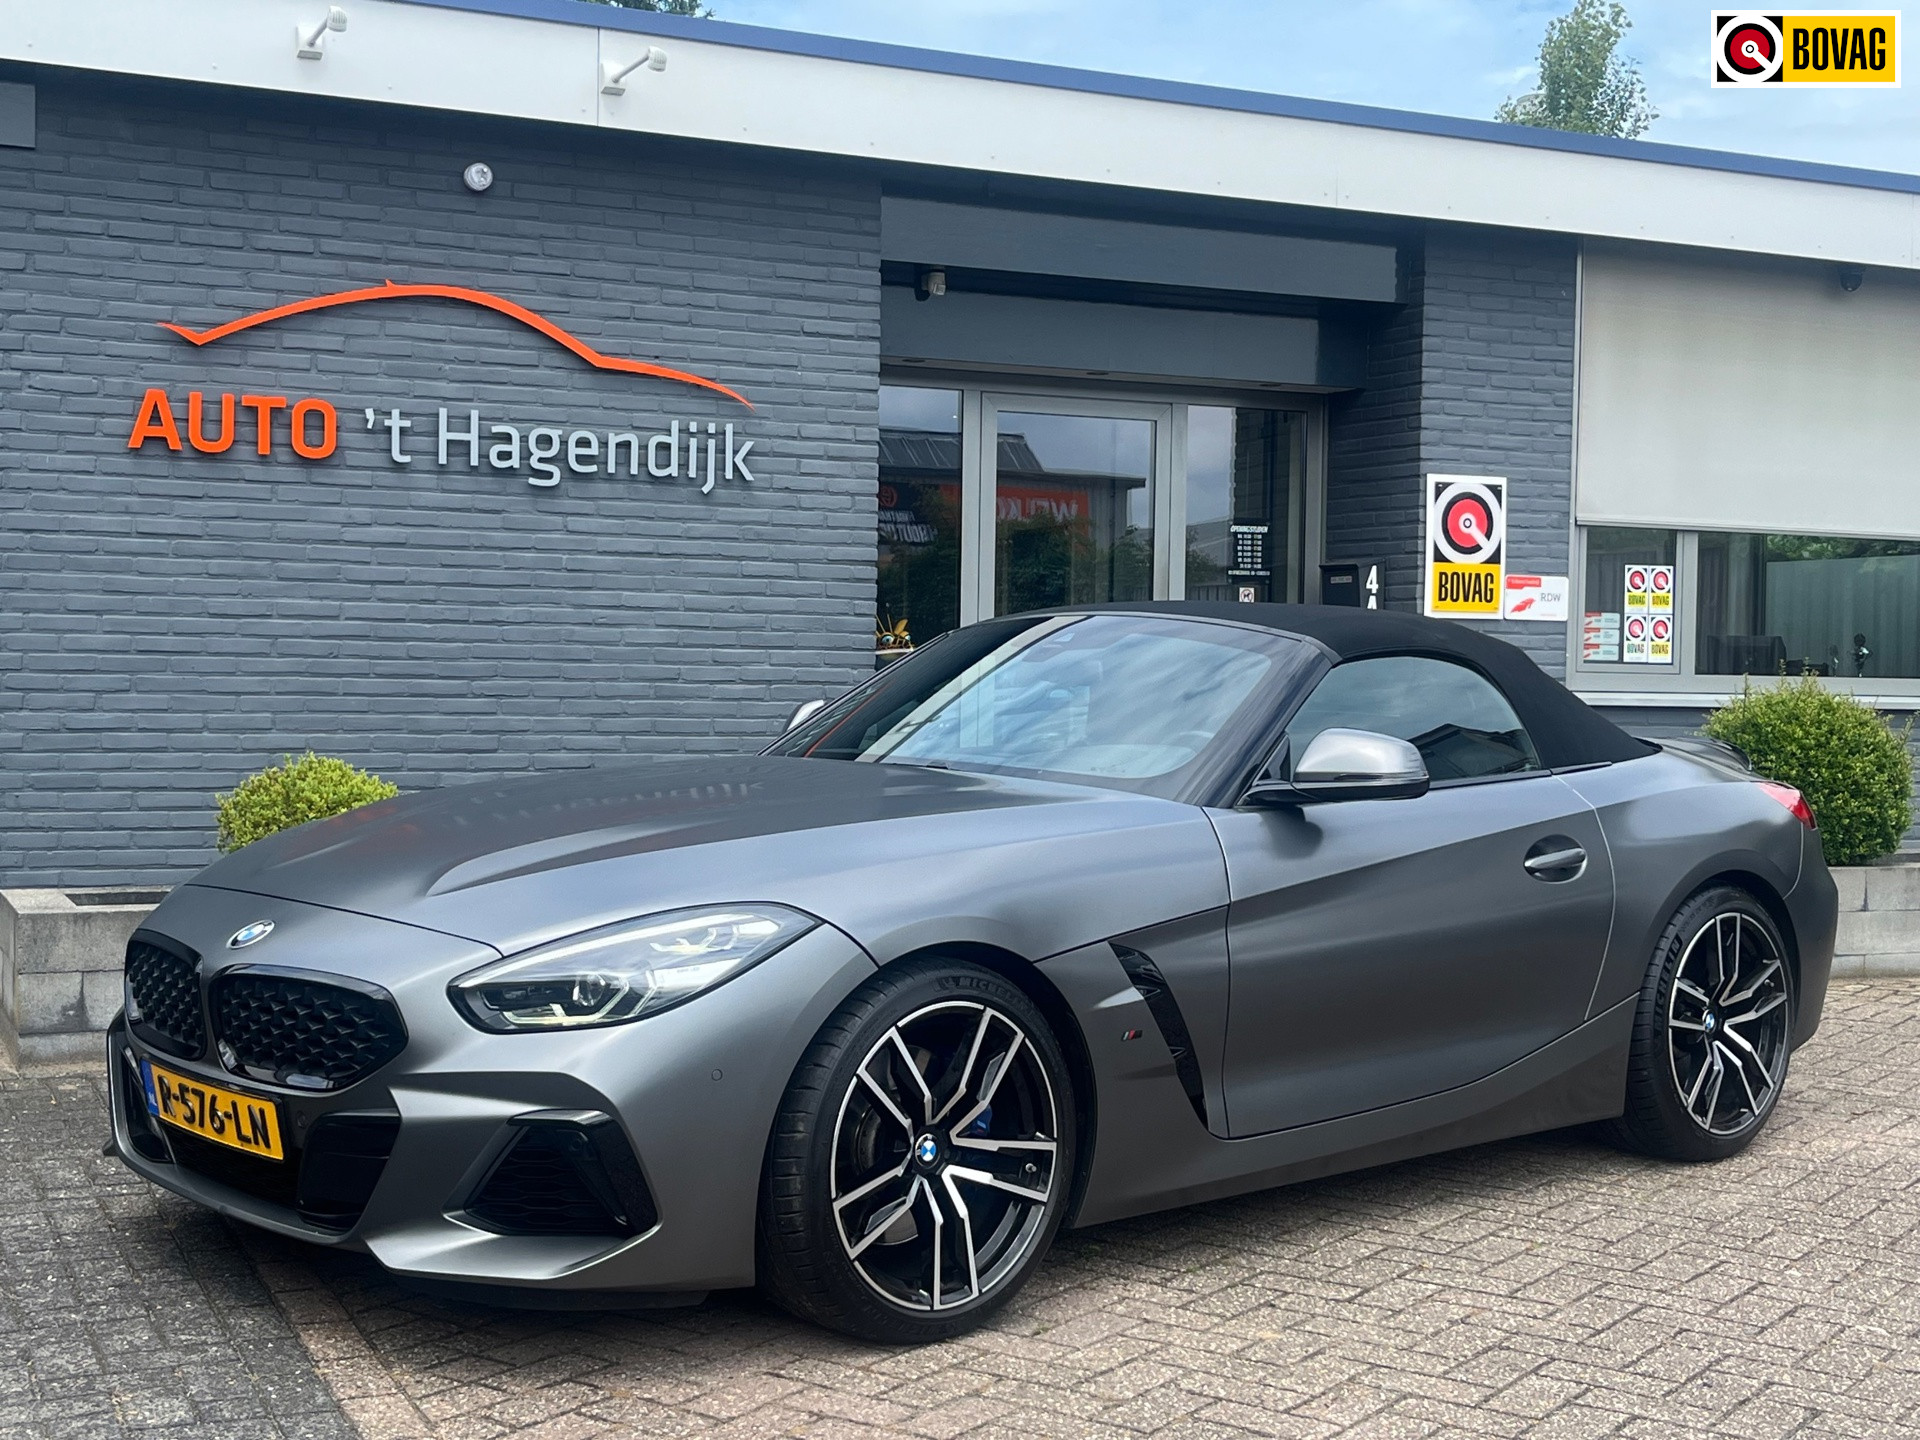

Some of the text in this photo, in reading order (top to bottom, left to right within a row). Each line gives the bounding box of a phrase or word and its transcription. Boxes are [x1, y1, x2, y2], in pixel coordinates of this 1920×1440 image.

[127, 388, 337, 459] AUTO
[438, 407, 755, 494] Hagendijk
[1366, 565, 1379, 594] 4
[1438, 571, 1494, 604] BOVAG
[1540, 592, 1561, 602] RDW
[1628, 594, 1646, 606] BOVAG
[1652, 595, 1670, 606] BOVAG
[1626, 643, 1645, 654] BOVAG
[1651, 644, 1669, 655] BOVAG
[157, 1073, 271, 1150] R-576-LN
